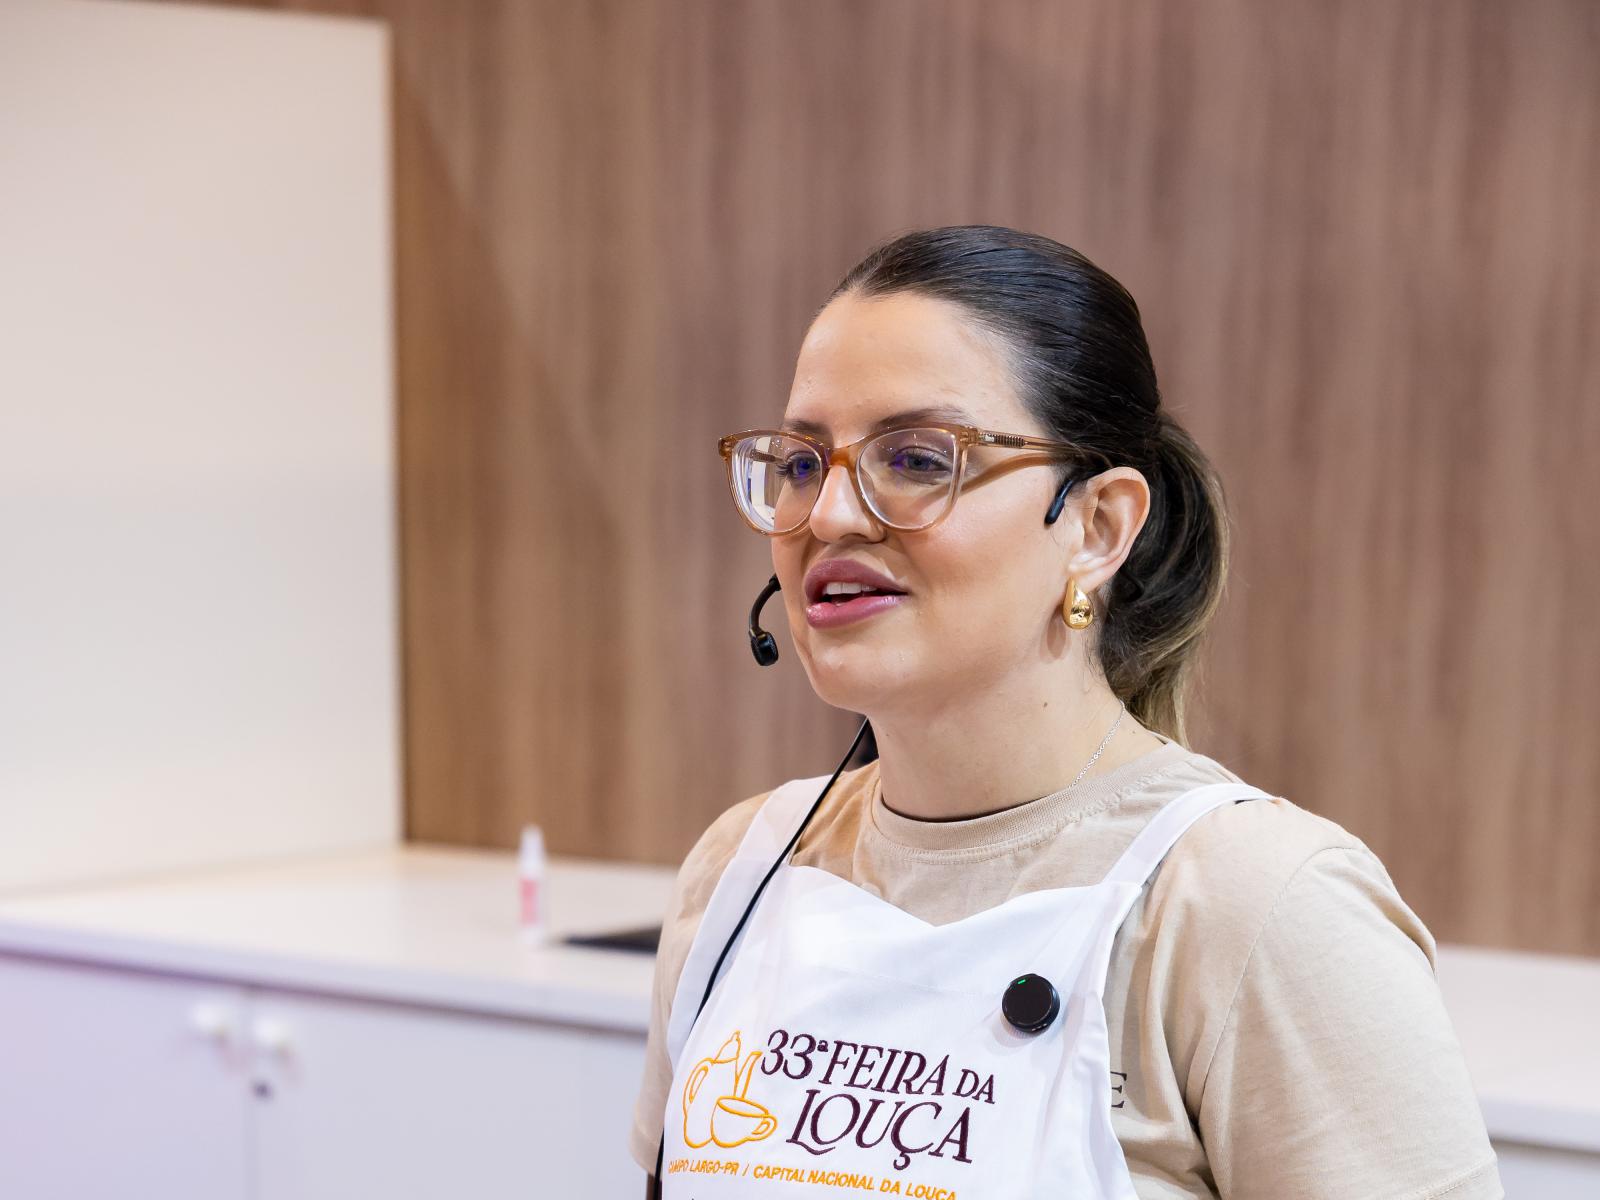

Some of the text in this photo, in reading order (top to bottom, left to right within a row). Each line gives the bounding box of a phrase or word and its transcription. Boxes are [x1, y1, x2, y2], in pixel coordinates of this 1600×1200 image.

[818, 1040, 950, 1096] FEIRA
[952, 1068, 996, 1104] DA
[785, 1089, 973, 1171] LOUÇA
[753, 1164, 805, 1183] CAPITAL
[807, 1170, 875, 1191] NACIONAL
[879, 1178, 901, 1195] DA
